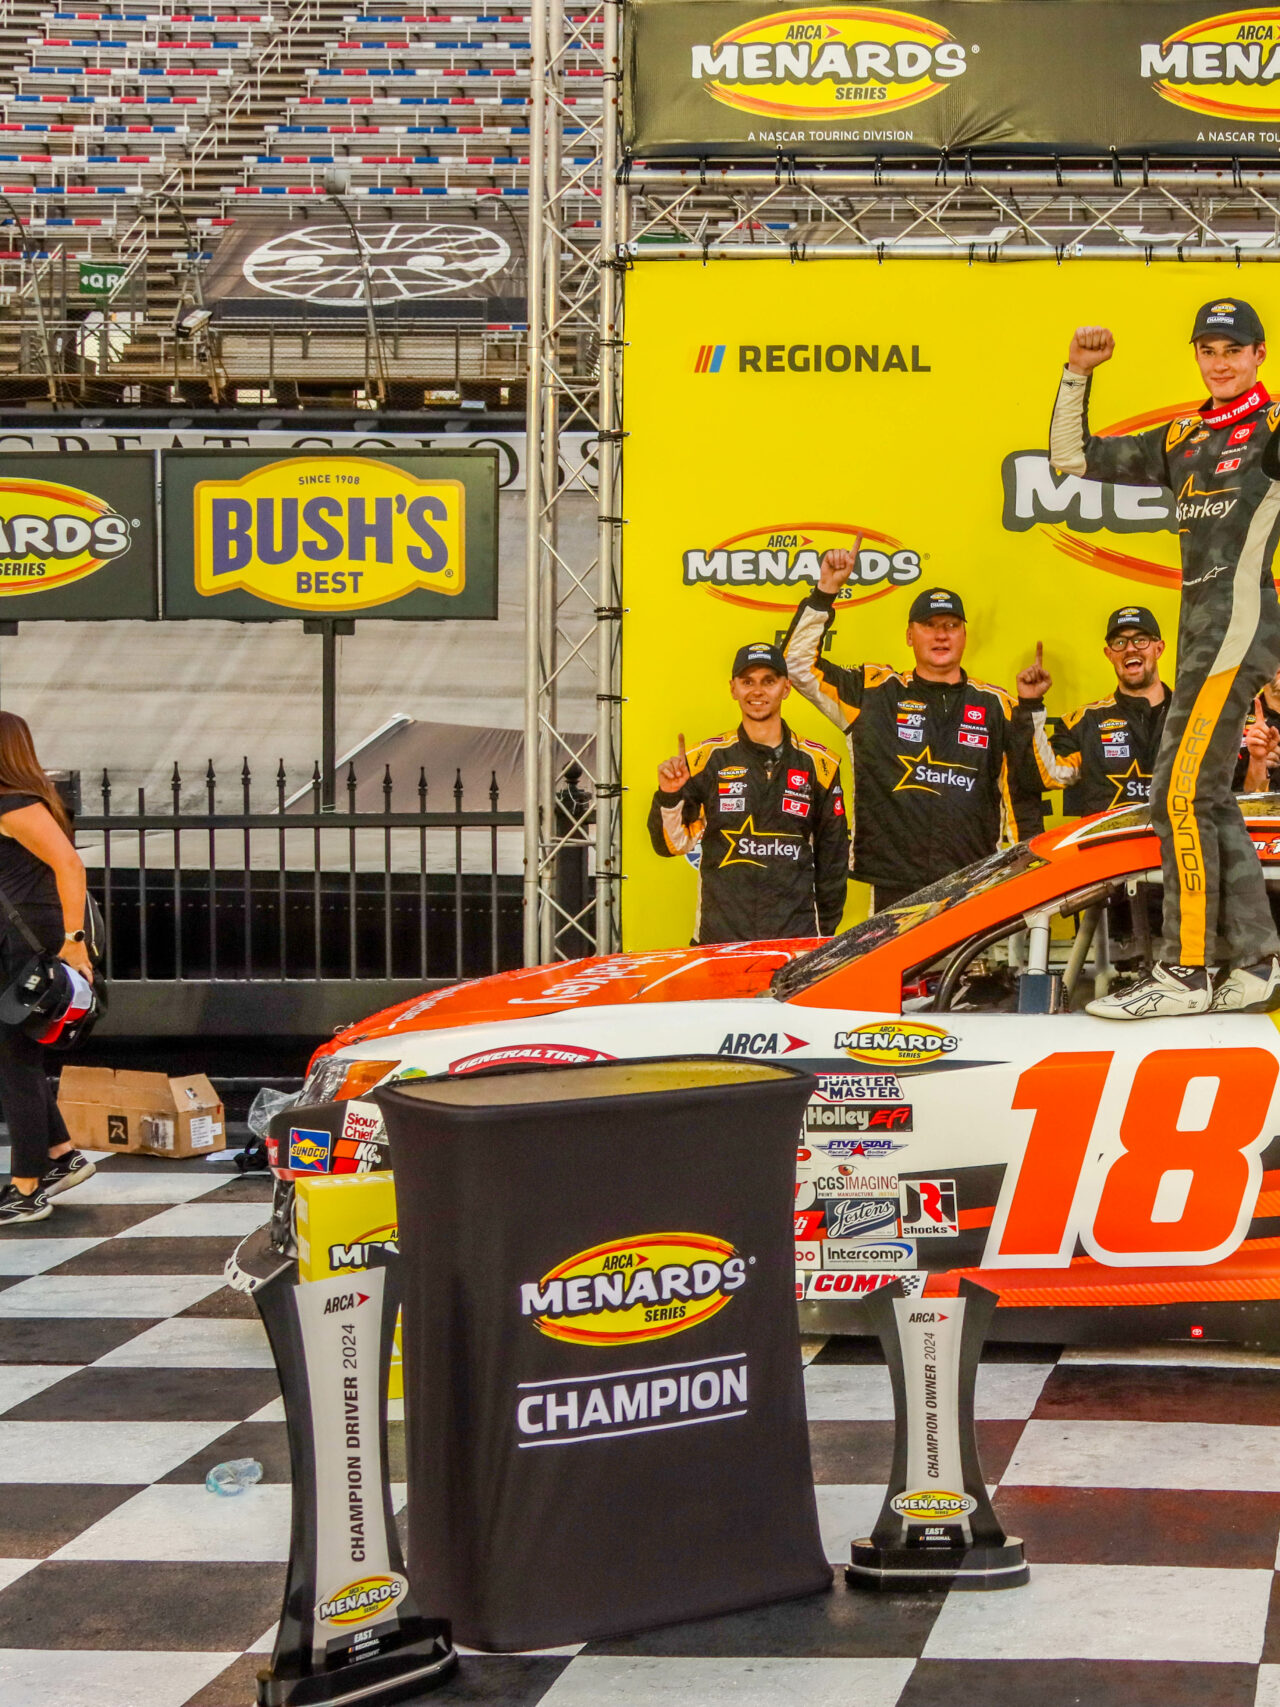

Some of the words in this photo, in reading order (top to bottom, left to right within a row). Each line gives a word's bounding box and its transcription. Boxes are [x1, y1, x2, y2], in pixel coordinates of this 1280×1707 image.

[786, 25, 823, 40] ARCA
[1236, 25, 1274, 41] ARCA
[691, 43, 967, 80] MENARDS
[835, 87, 887, 100] SERIES
[747, 131, 756, 141] A
[759, 131, 805, 141] NASCAR
[809, 131, 860, 141] TOURING
[863, 130, 914, 141] DIVISION
[1196, 132, 1206, 142] A
[1208, 132, 1255, 143] NASCAR
[739, 344, 931, 374] REGIONAL
[298, 475, 332, 486] SINCE
[335, 475, 361, 486] 1908
[211, 493, 449, 577] BUSH'S
[767, 535, 798, 548] ARCA
[296, 571, 364, 594] BEST
[914, 765, 976, 792] Starkey
[738, 838, 801, 860] Starkey
[718, 1033, 779, 1055] ARCA
[835, 1032, 958, 1052] MENARDS
[454, 1049, 543, 1073] GENERAL
[544, 1049, 591, 1064] TIRE
[829, 1086, 900, 1100] MASTER
[346, 1112, 379, 1130] Sioux
[807, 1106, 871, 1131] Holley
[344, 1124, 375, 1141] Chief
[291, 1144, 328, 1160] SUNOCO
[828, 1141, 859, 1150] FIVE
[861, 1141, 894, 1150] STAR
[996, 1046, 1280, 1256] 18
[831, 1201, 894, 1238] Jostens
[903, 1224, 948, 1235] shocks
[602, 1253, 634, 1272] ARCA
[827, 1247, 904, 1263] Intercomp
[520, 1258, 747, 1315] MENARDS
[323, 1292, 355, 1315] ARCA
[644, 1305, 687, 1323] SERIES
[908, 1312, 936, 1323] ARCA
[341, 1323, 358, 1369] 2024
[924, 1332, 936, 1361] 2024
[925, 1364, 938, 1410] OWNER
[517, 1365, 748, 1435] CHAMPION
[345, 1376, 360, 1449] DRIVER
[927, 1412, 939, 1479] CHAMPION
[348, 1456, 366, 1563] CHAMPION
[895, 1498, 970, 1511] MENARDS
[924, 1527, 945, 1535] EAST
[319, 1581, 401, 1620] MENARDS
[353, 1628, 374, 1644] EAST
